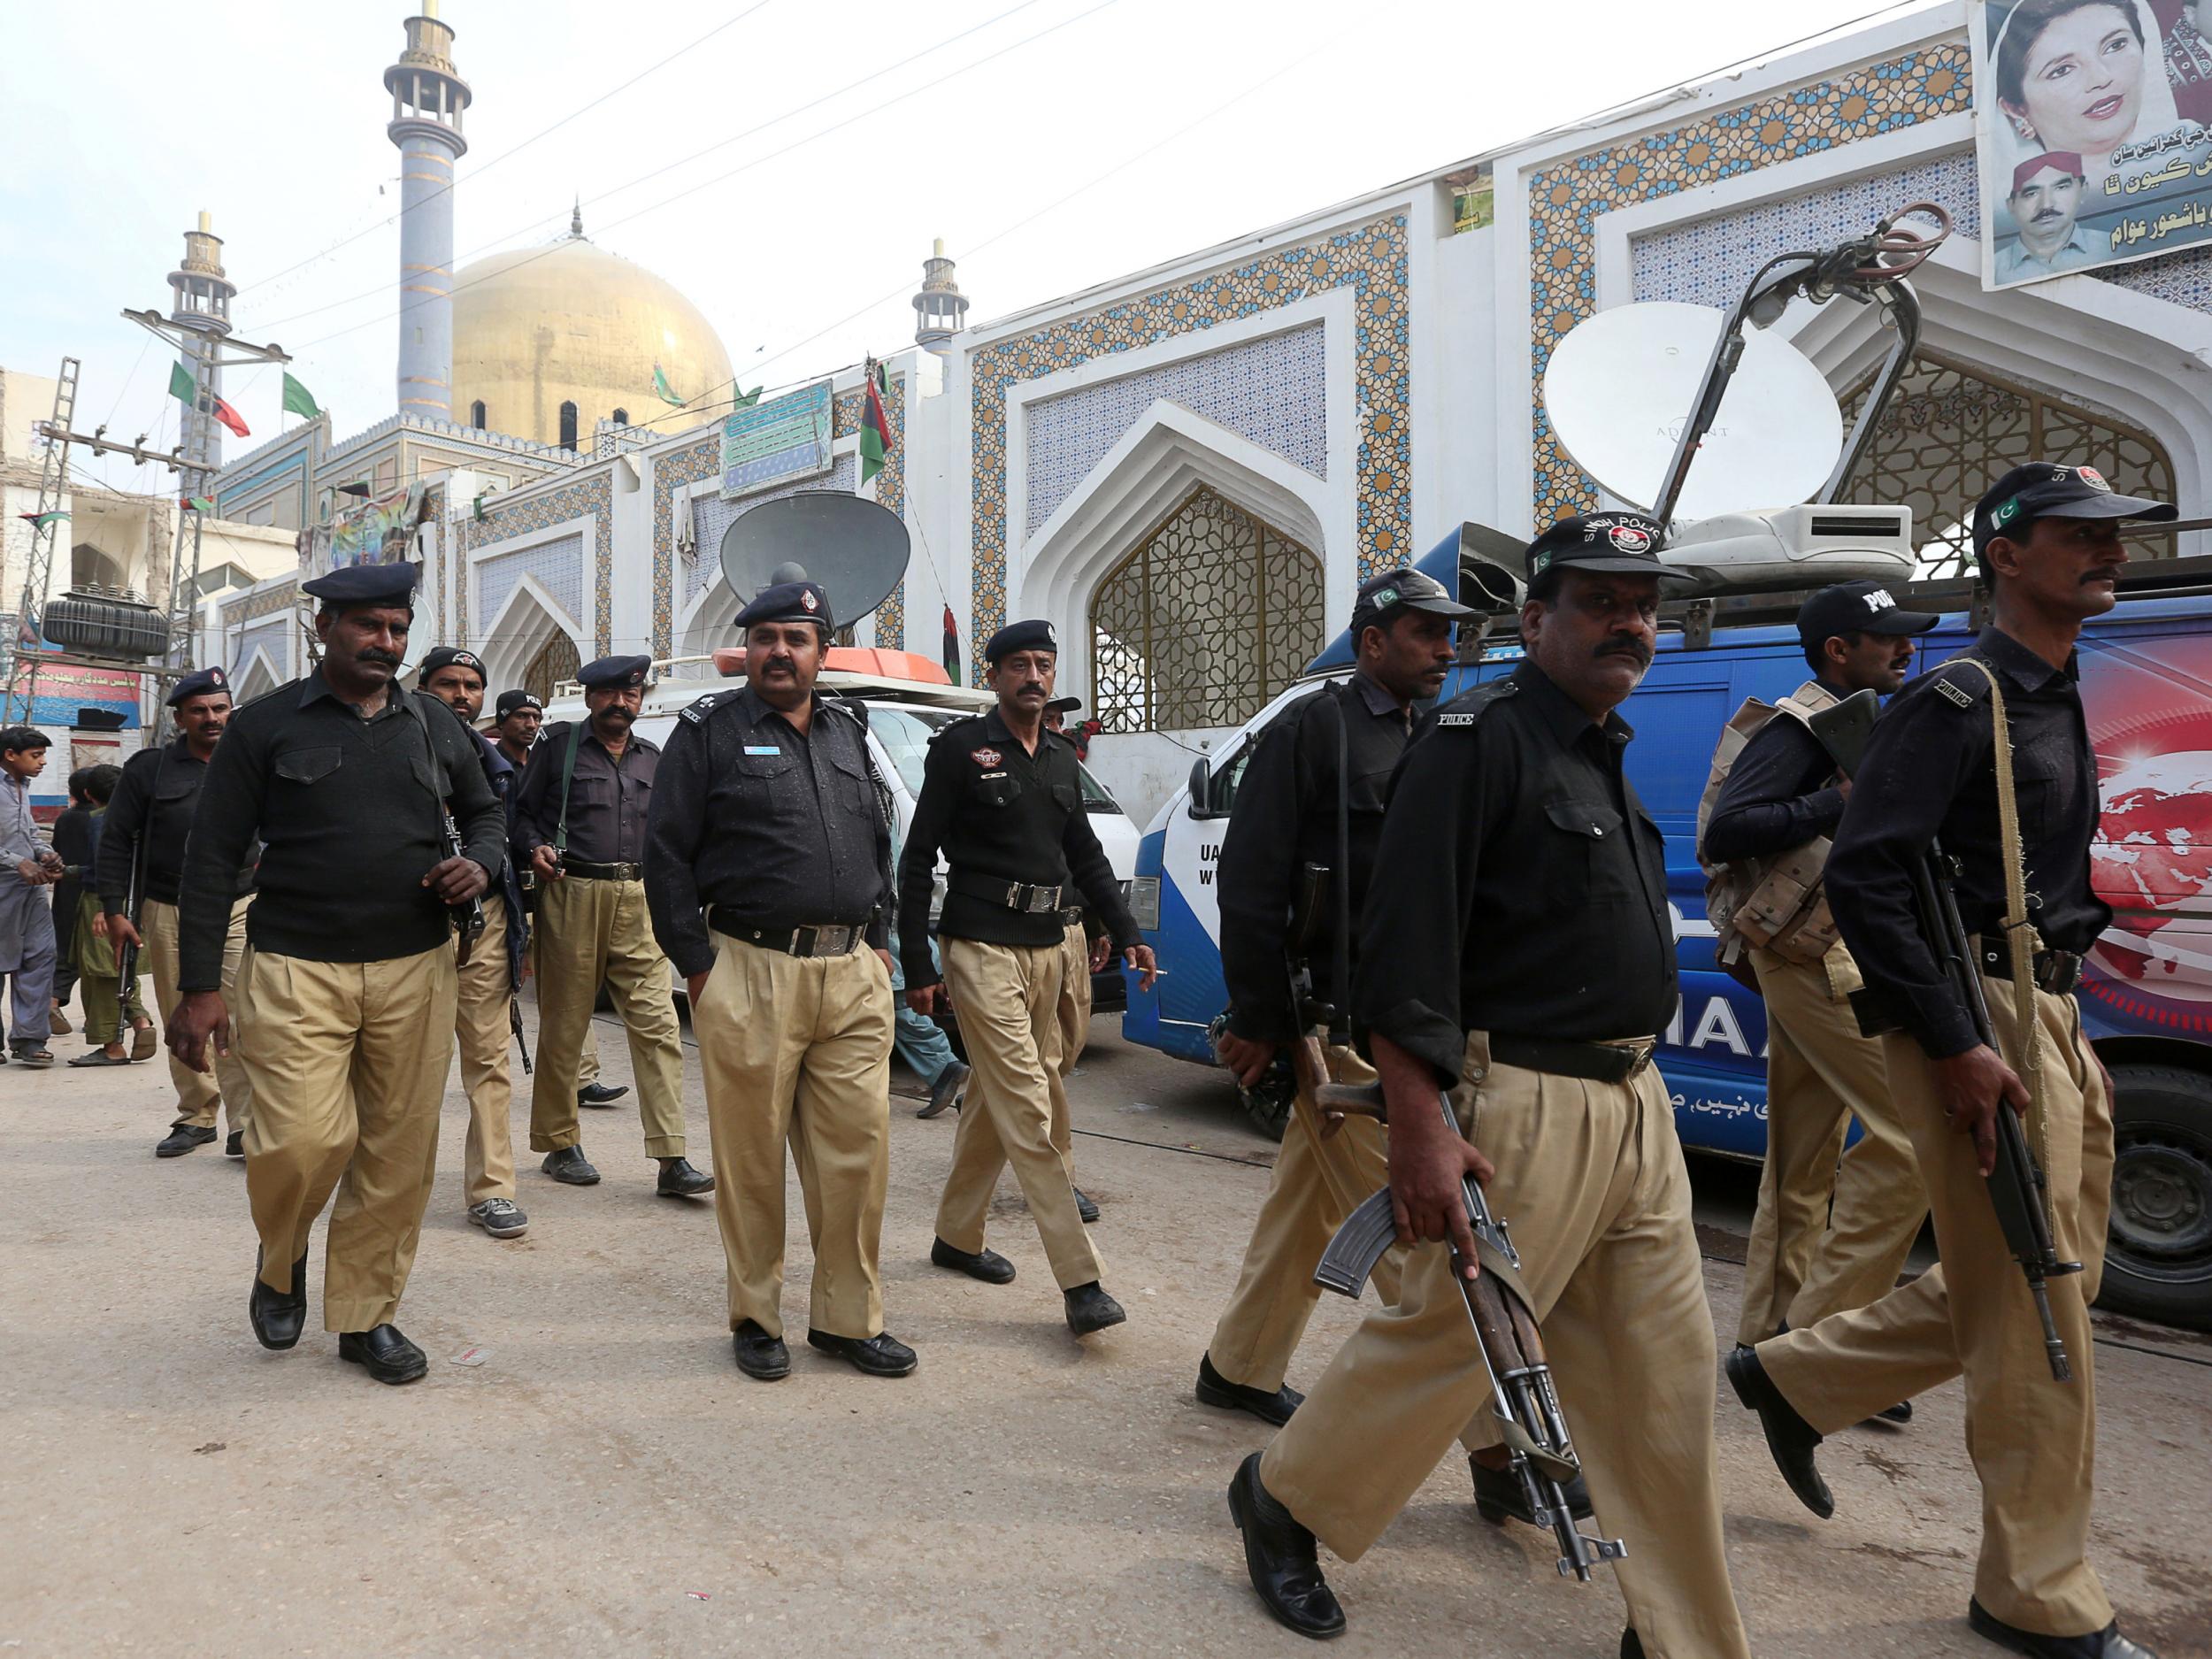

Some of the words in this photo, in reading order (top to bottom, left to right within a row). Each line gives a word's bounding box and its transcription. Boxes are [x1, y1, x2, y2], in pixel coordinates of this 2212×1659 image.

[2110, 219, 2147, 252] عوام
[1583, 518, 1615, 542] SINDH
[1618, 516, 1661, 540] POLIC
[1437, 713, 1475, 726] POLICE
